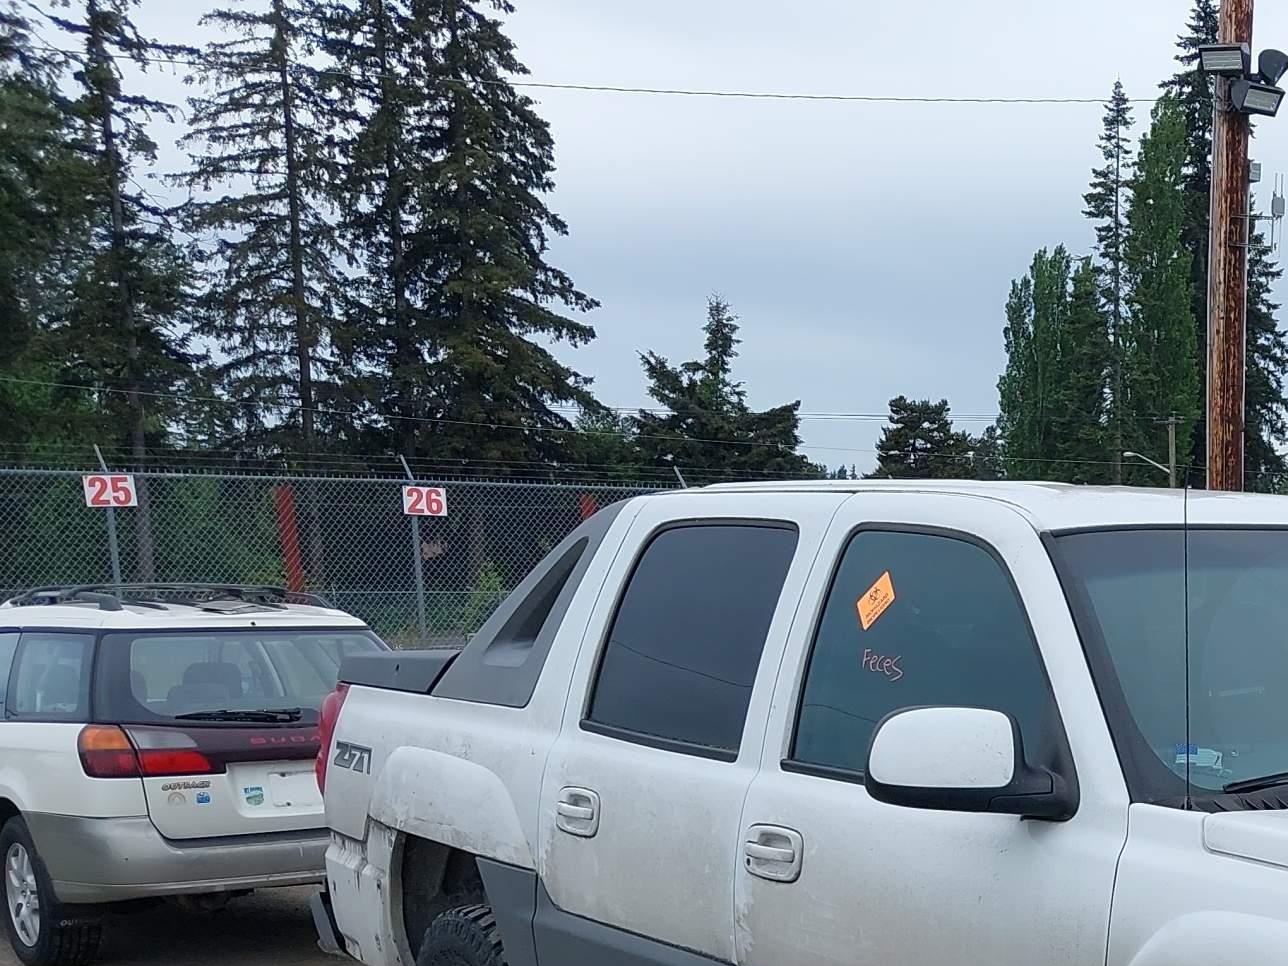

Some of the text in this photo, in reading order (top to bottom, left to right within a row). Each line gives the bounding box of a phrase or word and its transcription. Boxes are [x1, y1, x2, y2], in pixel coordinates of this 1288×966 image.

[87, 476, 133, 506] 25
[406, 487, 444, 515] 26
[333, 740, 373, 776] Z71
[161, 779, 212, 792] OUTBACK
